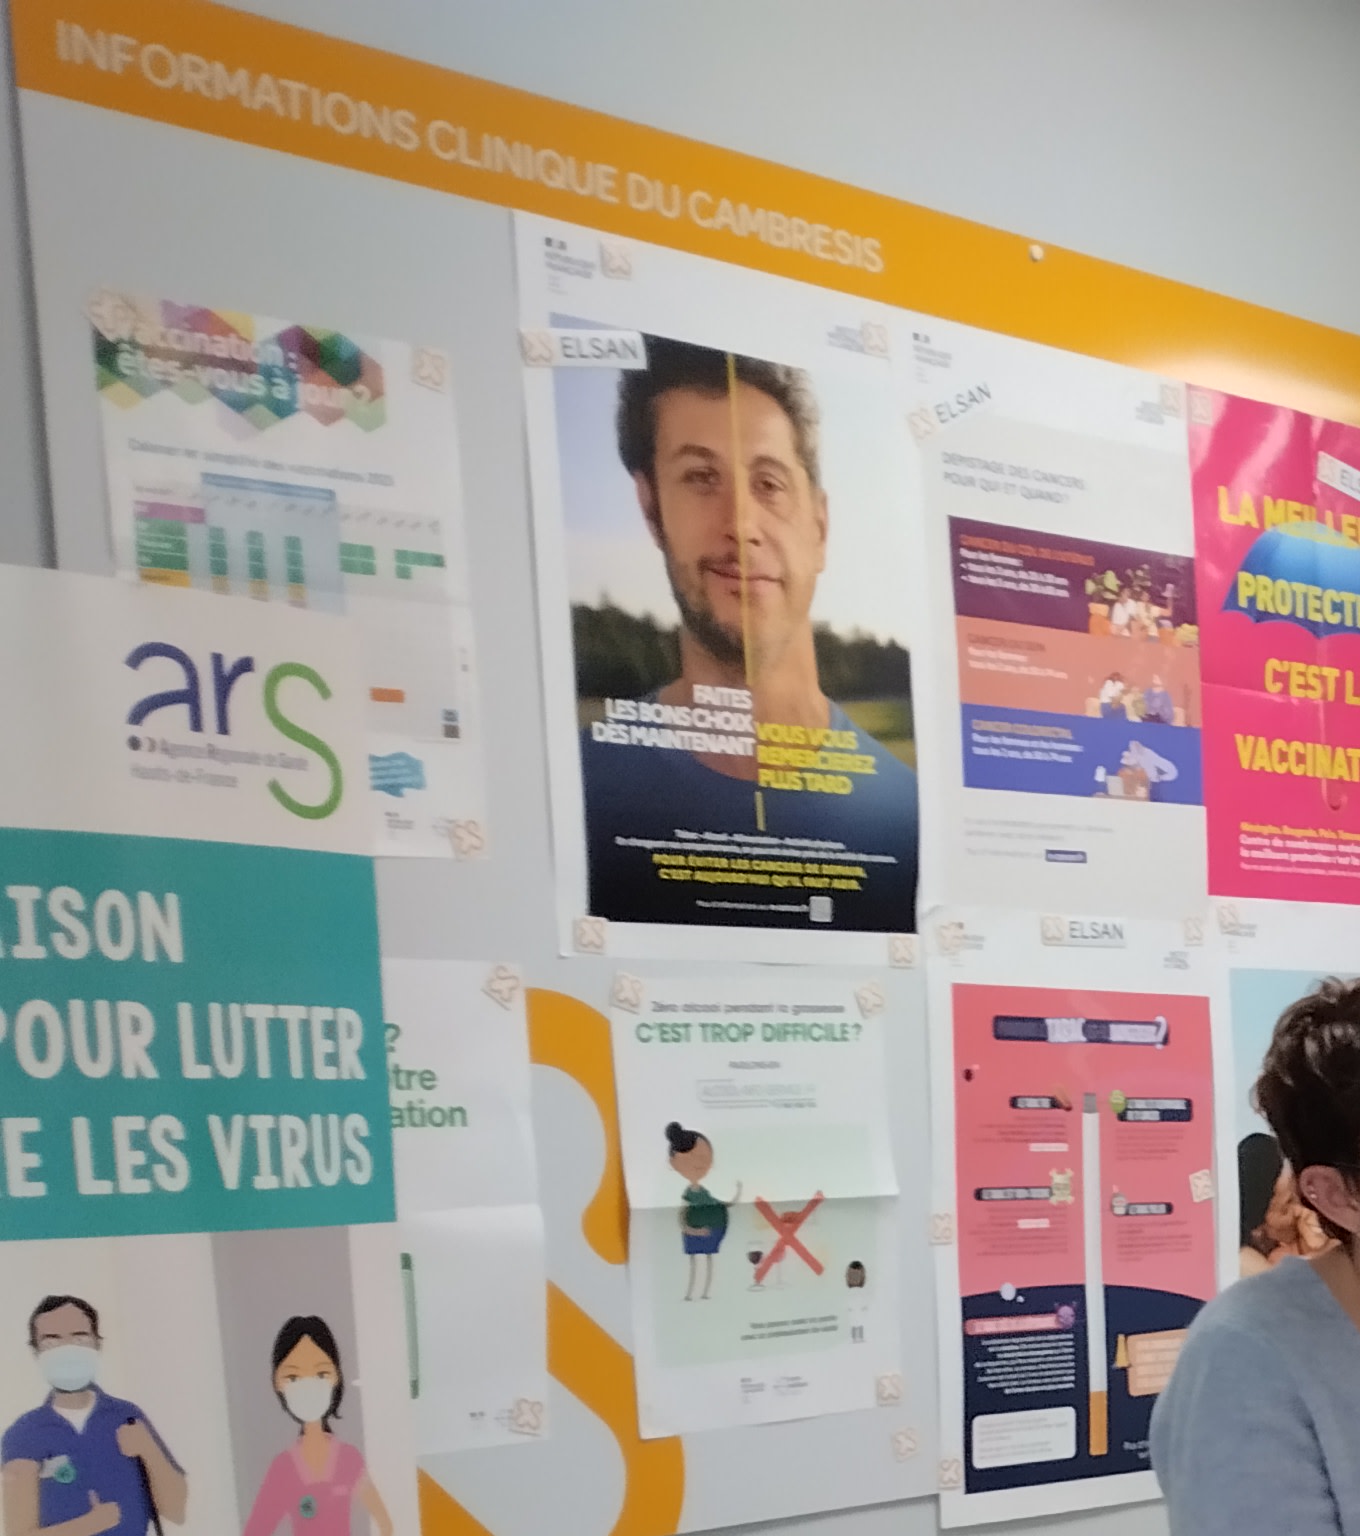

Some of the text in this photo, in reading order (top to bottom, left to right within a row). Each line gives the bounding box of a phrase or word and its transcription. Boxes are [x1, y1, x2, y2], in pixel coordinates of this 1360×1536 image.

[56, 20, 884, 273] INFORMATIONS CLINIQUE DU CAMBRESIS
[560, 336, 638, 361] ELSAN
[935, 382, 992, 424] ELSAN
[1217, 485, 1259, 529] LA
[1264, 657, 1340, 702] C'EST
[124, 641, 344, 820] ars
[605, 698, 754, 734] LES BONS CHOIX
[630, 726, 756, 757] MAINTENANT
[0, 883, 184, 963] ISON
[1069, 920, 1125, 940] ELSAN
[0, 998, 366, 1080] OUR LUTTER
[635, 1021, 693, 1044] C'EST
[699, 1022, 755, 1043] TROP
[71, 1114, 190, 1195] LES
[207, 1113, 373, 1191] VIRUS
